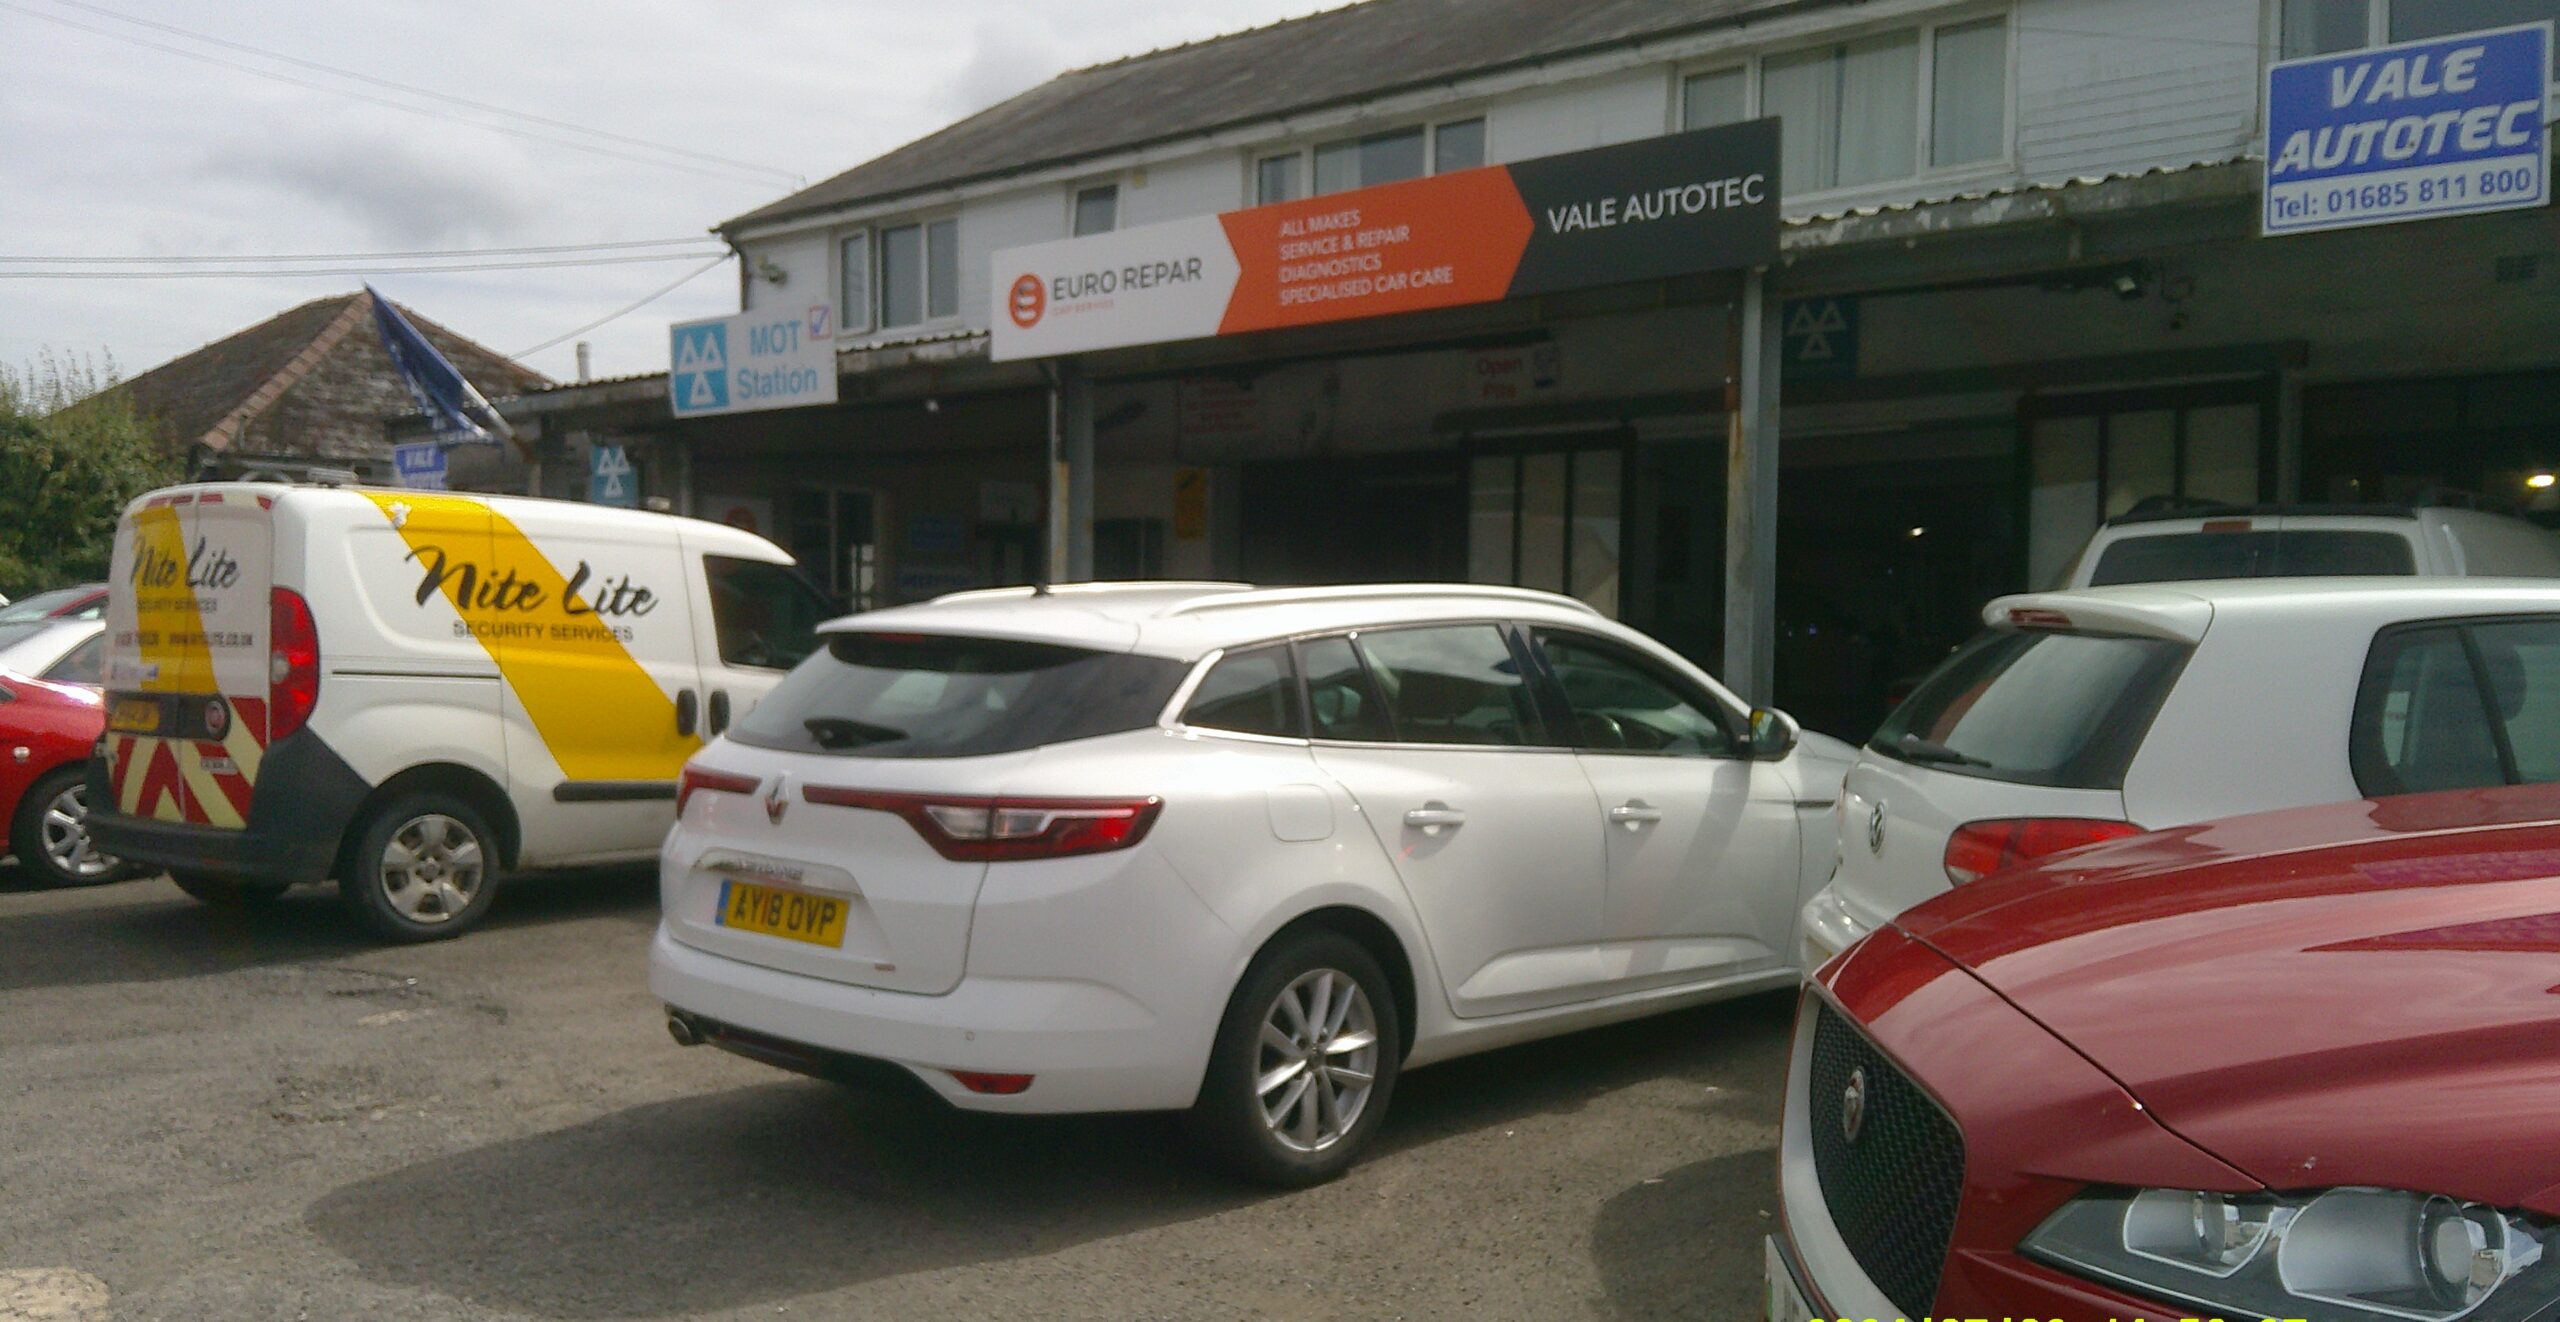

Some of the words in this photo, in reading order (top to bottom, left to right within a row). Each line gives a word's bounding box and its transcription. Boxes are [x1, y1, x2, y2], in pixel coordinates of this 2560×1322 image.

[2331, 46, 2485, 109] VALE
[2272, 100, 2540, 175] AUTOTEC
[1548, 198, 1617, 234] VALE
[1622, 173, 1765, 223] AUTOTEC
[2275, 192, 2318, 218] Tel:
[2327, 181, 2408, 214] 01685
[2419, 175, 2466, 202] 811
[2480, 167, 2532, 195] 800
[1280, 219, 1305, 237] ALL
[1308, 209, 1361, 232] MAKES
[1280, 235, 1339, 260] SERVICE
[1341, 234, 1353, 251] &
[1356, 225, 1410, 249] REPAIR
[1053, 270, 1118, 301] EURO
[1123, 257, 1203, 291] REPAR
[1279, 253, 1382, 283] DIAGNOSTICS
[1280, 278, 1373, 306] SPECIALISED
[1375, 272, 1408, 294] CAR
[1410, 266, 1454, 289] CARE
[751, 319, 802, 356] MOT
[737, 366, 818, 400] Station
[130, 534, 177, 588] Nite
[186, 536, 240, 589] Lite
[405, 545, 548, 611] Nite
[562, 560, 659, 617] Lite
[453, 619, 546, 641] SECURITY
[551, 621, 634, 643] SERVICES
[734, 884, 784, 927] AY18
[787, 895, 837, 937] OVP
